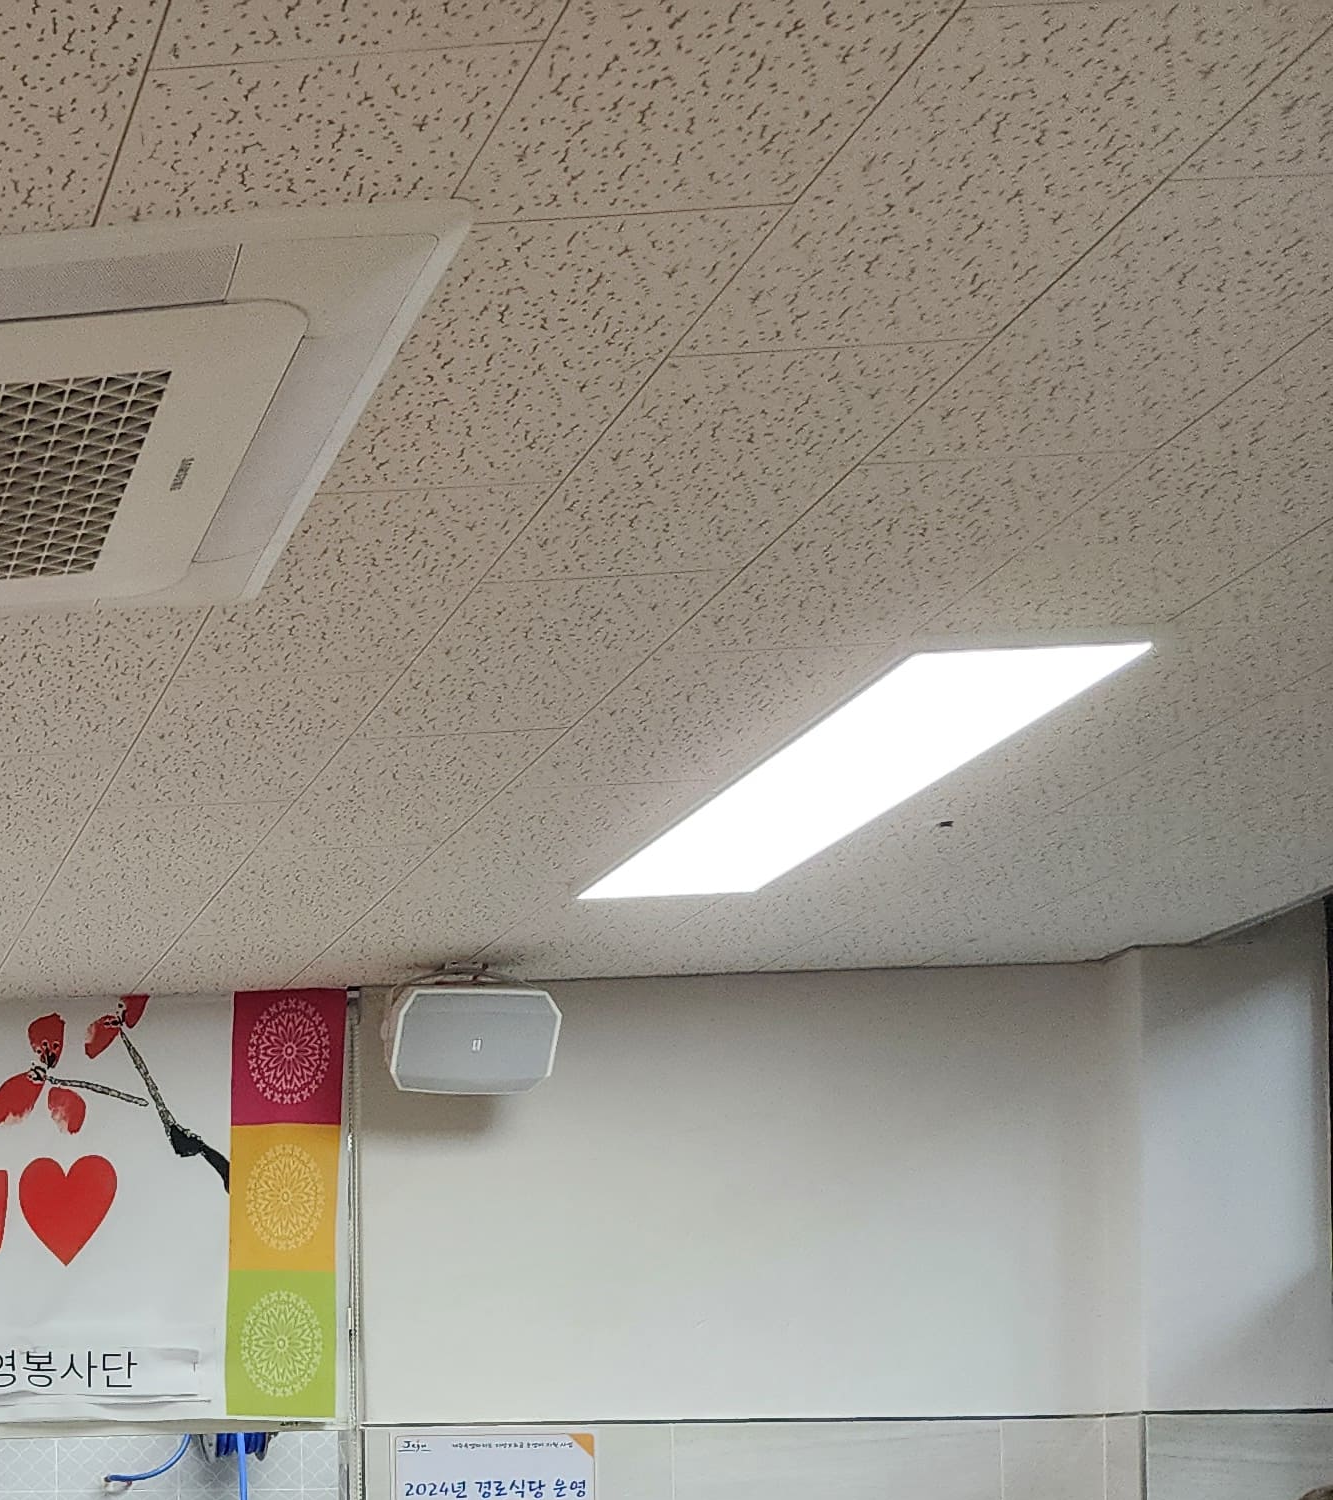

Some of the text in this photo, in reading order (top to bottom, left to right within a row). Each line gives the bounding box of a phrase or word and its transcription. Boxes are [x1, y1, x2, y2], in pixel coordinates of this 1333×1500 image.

[405, 1479, 585, 1498] 2024년 경로식당 운영
